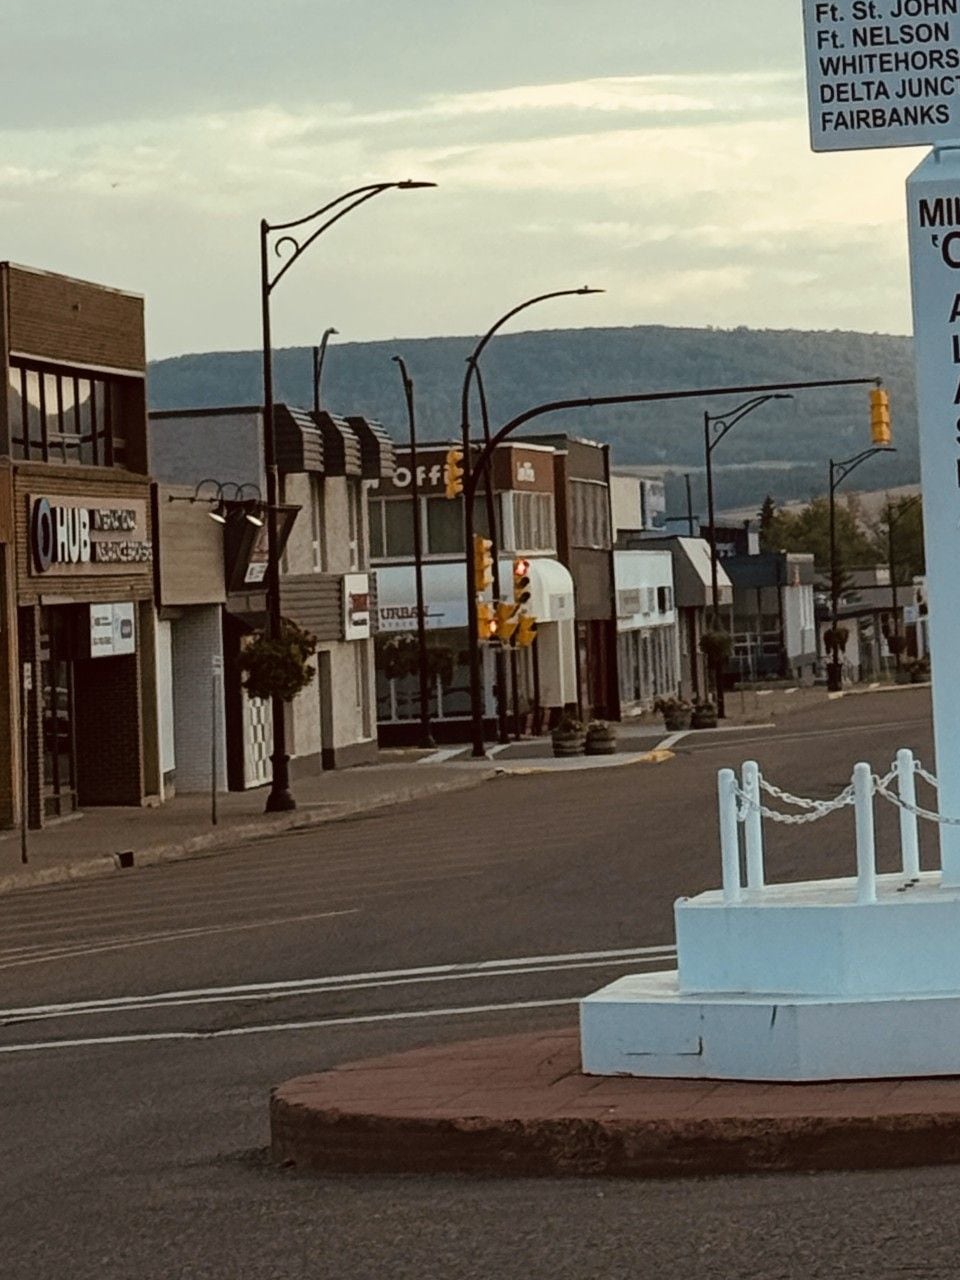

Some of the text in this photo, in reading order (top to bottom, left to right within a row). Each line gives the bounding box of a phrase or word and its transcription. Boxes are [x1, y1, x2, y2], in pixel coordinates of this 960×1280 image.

[815, 2, 845, 24] Ft.
[852, 0, 883, 21] St.
[816, 29, 845, 51] Ft.
[852, 21, 950, 48] NELSON
[819, 79, 891, 104] DELTA
[821, 103, 950, 132] FAIRBANKS
[56, 507, 91, 563] HUB
